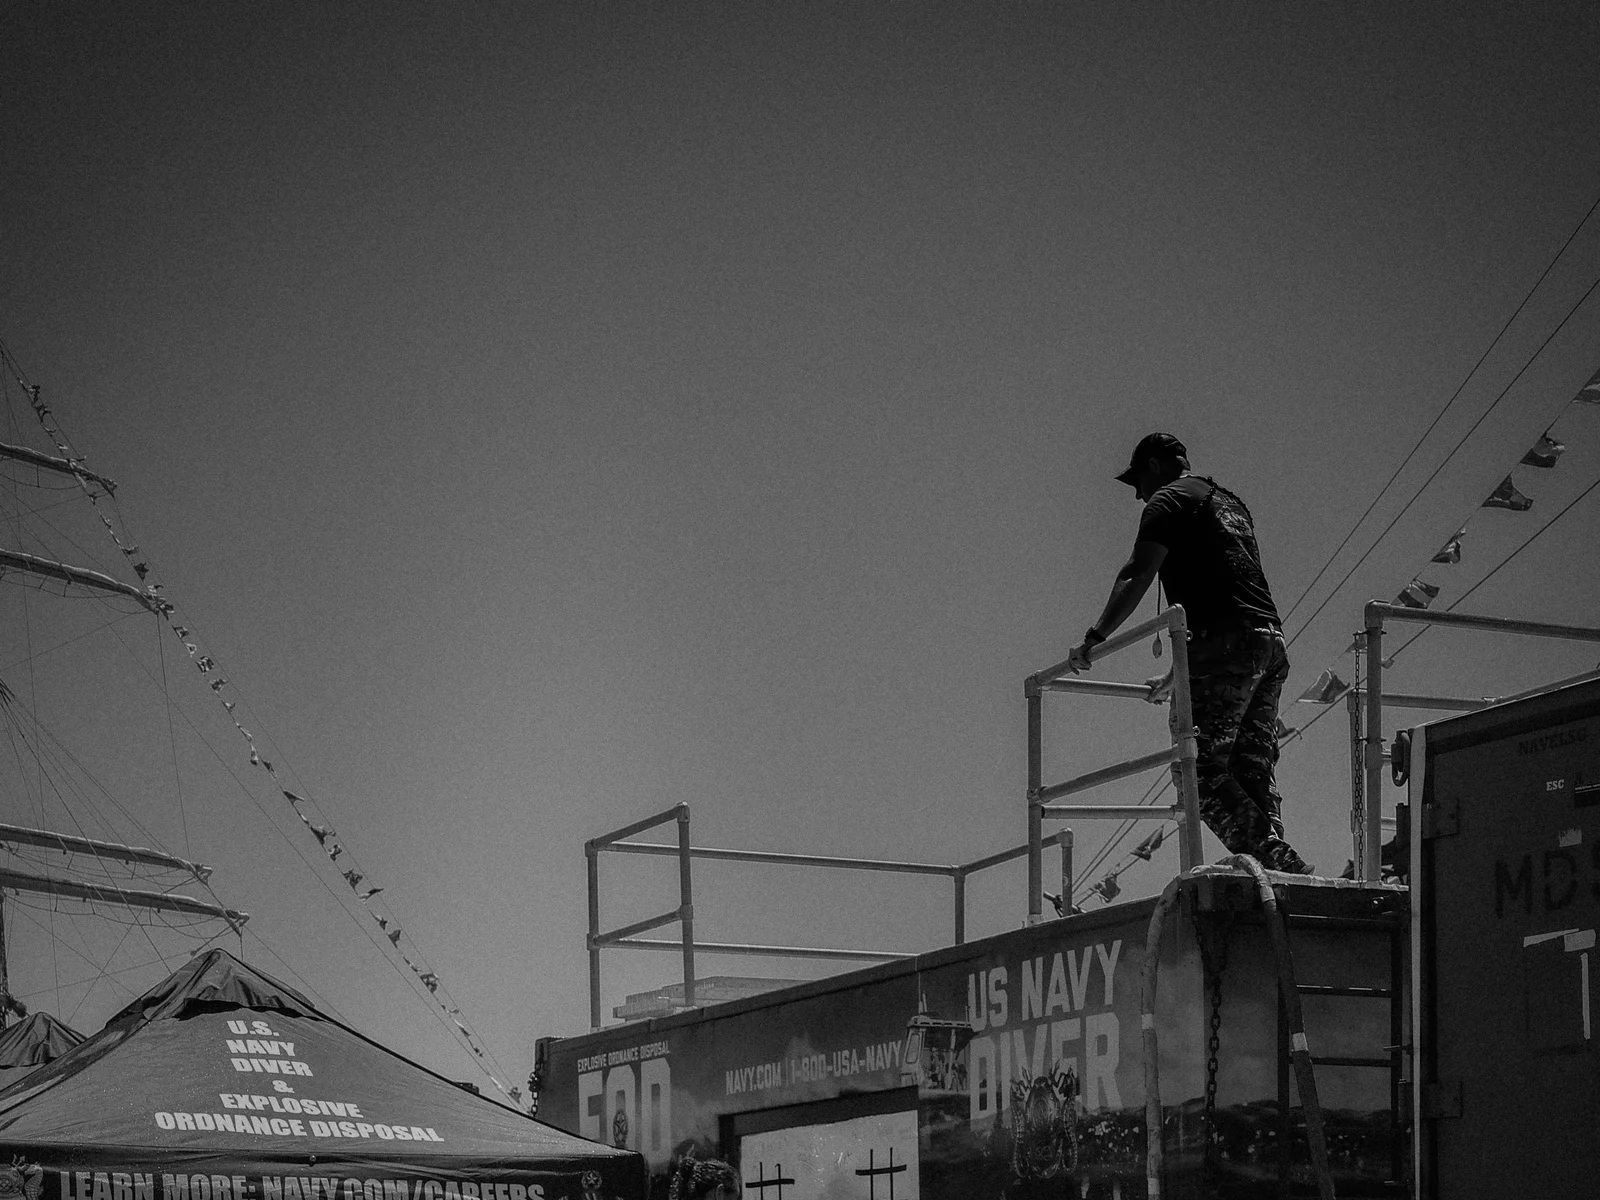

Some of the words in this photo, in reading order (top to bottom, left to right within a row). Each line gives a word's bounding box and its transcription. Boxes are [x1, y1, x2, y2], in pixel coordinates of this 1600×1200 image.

[1545, 779, 1565, 792] ESC
[1495, 841, 1600, 920] MD
[968, 966, 1008, 1033] US
[1022, 940, 1122, 1021] NAVY
[226, 1020, 279, 1037] U.S.
[226, 1039, 296, 1057] NAVY
[577, 1053, 607, 1073] EXPLOSIVE
[608, 1046, 640, 1066] ORDNANCE
[640, 1040, 671, 1059] DISPOSAL
[231, 1058, 313, 1077] DIVER
[726, 1062, 782, 1095] NAVY.COM
[791, 1040, 902, 1085] 1-800-USA-NAVY
[970, 1012, 1123, 1131] DIVER
[272, 1079, 295, 1094] &
[219, 1094, 364, 1119] EXPLOSIVE
[578, 1057, 671, 1176] EOD
[154, 1111, 308, 1137] ORDNANCE
[308, 1120, 445, 1142] DISPOSAL
